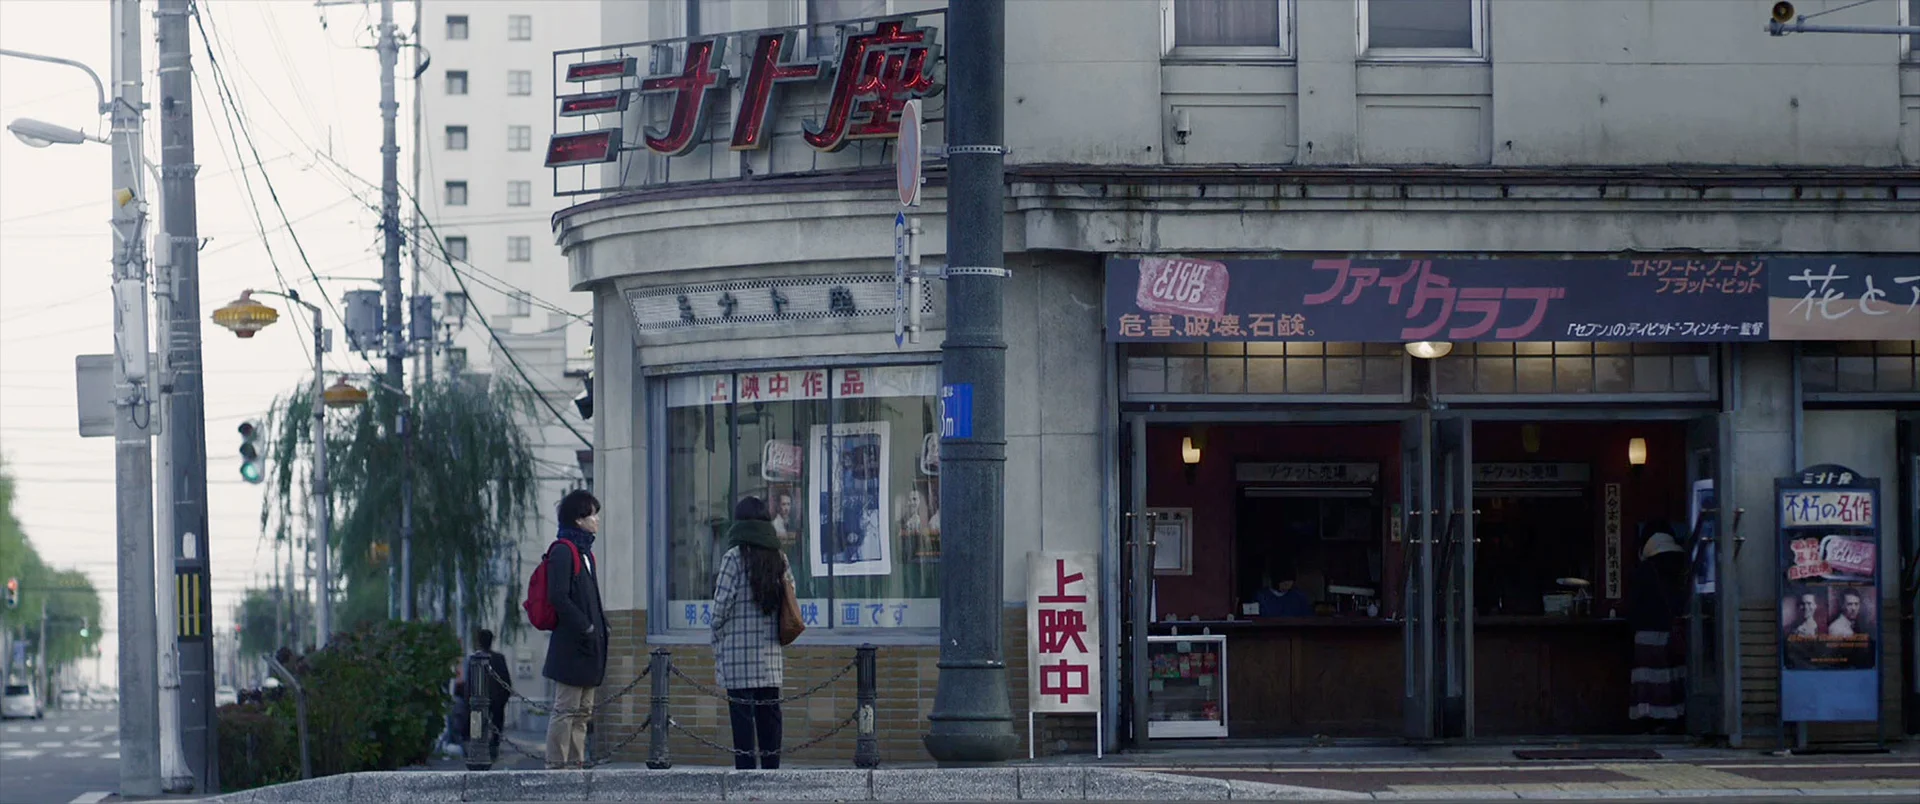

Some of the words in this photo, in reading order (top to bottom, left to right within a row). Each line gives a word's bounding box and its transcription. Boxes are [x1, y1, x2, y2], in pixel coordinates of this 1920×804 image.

[545, 18, 937, 167] ミナト座
[1163, 259, 1211, 282] FIGHT
[1627, 259, 1763, 277] エドワード・ノートン
[1152, 275, 1206, 304] CLUB
[1303, 259, 1449, 319] ファイト
[1656, 277, 1761, 294] ブラッド・ピット
[1119, 313, 1315, 337] 危害、破壊、石鹸。
[1400, 287, 1565, 339] クラブ
[711, 370, 865, 402] 上映中作品
[1803, 472, 1853, 485] ミナト座
[1785, 494, 1871, 522] 不朽の名作
[1038, 558, 1090, 704] 上映中
